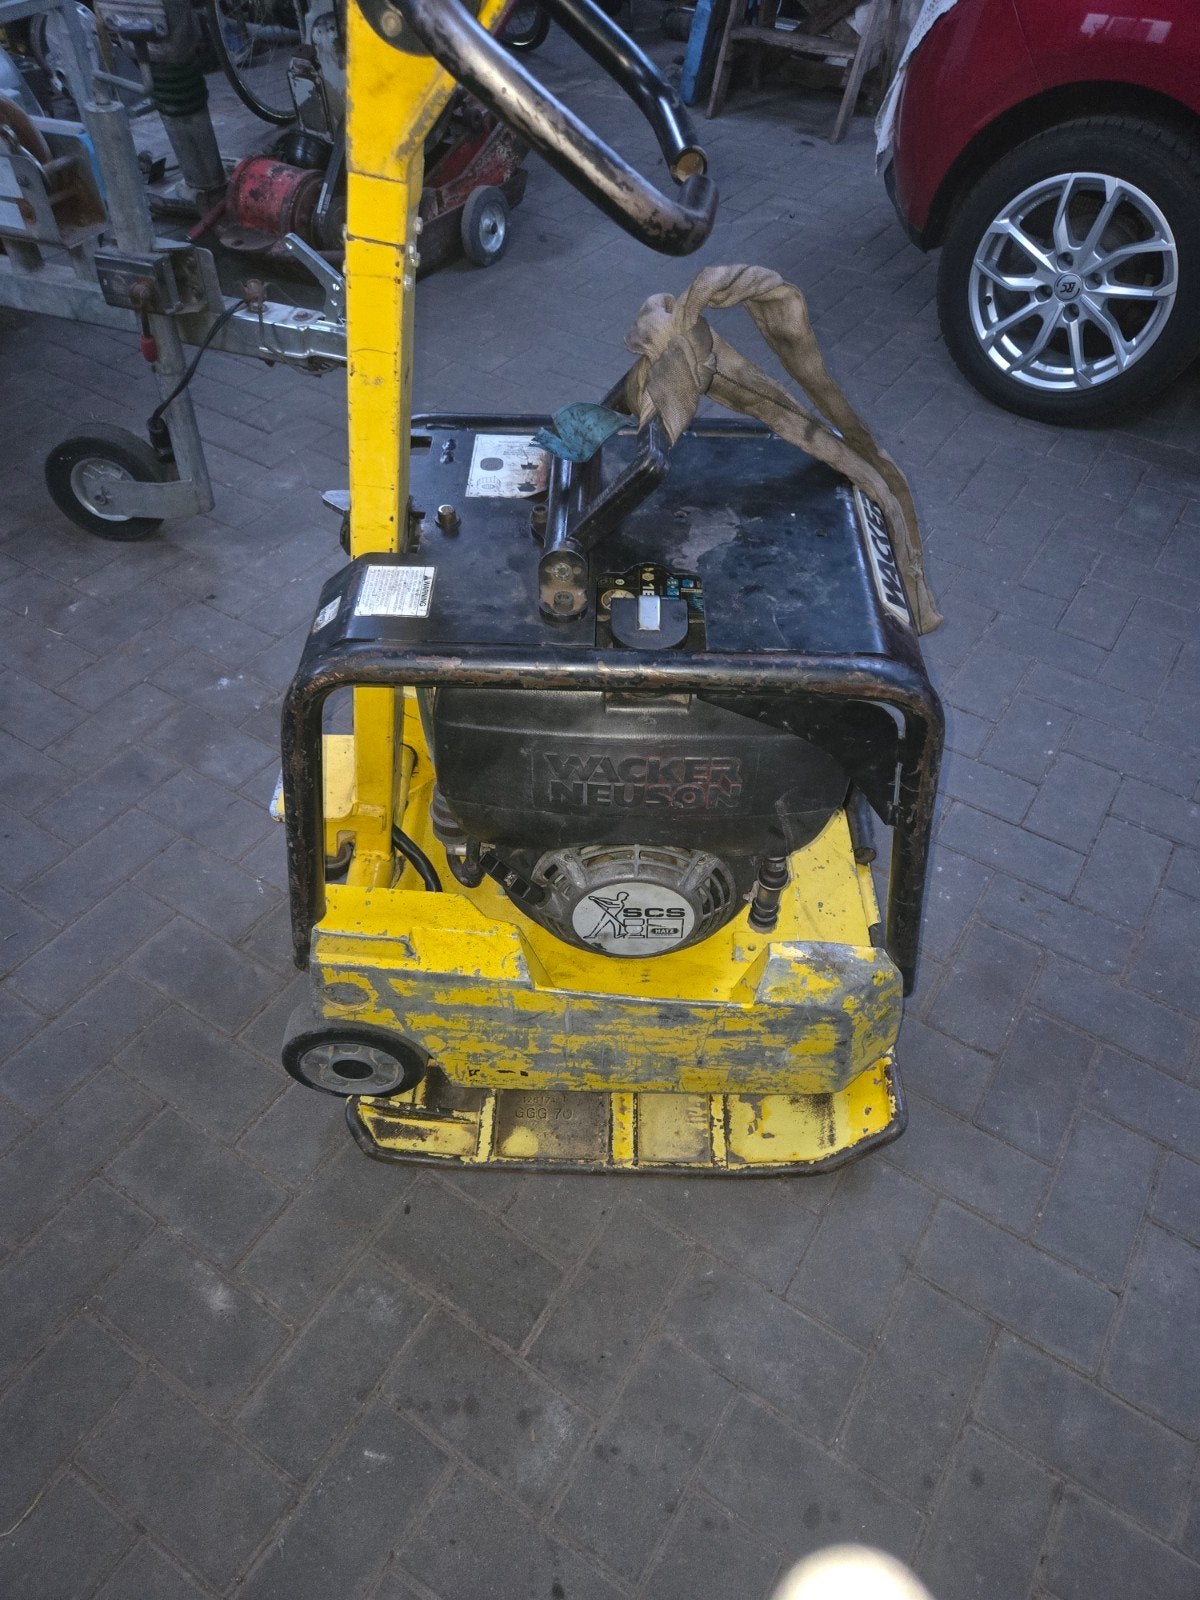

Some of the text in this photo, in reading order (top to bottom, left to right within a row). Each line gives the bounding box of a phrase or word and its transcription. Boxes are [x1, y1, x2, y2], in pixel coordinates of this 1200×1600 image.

[419, 580, 431, 607] WARNING
[543, 753, 743, 783] WACKER
[550, 780, 742, 809] NEUSON
[622, 907, 686, 918] SCS
[515, 1107, 547, 1119] GGG
